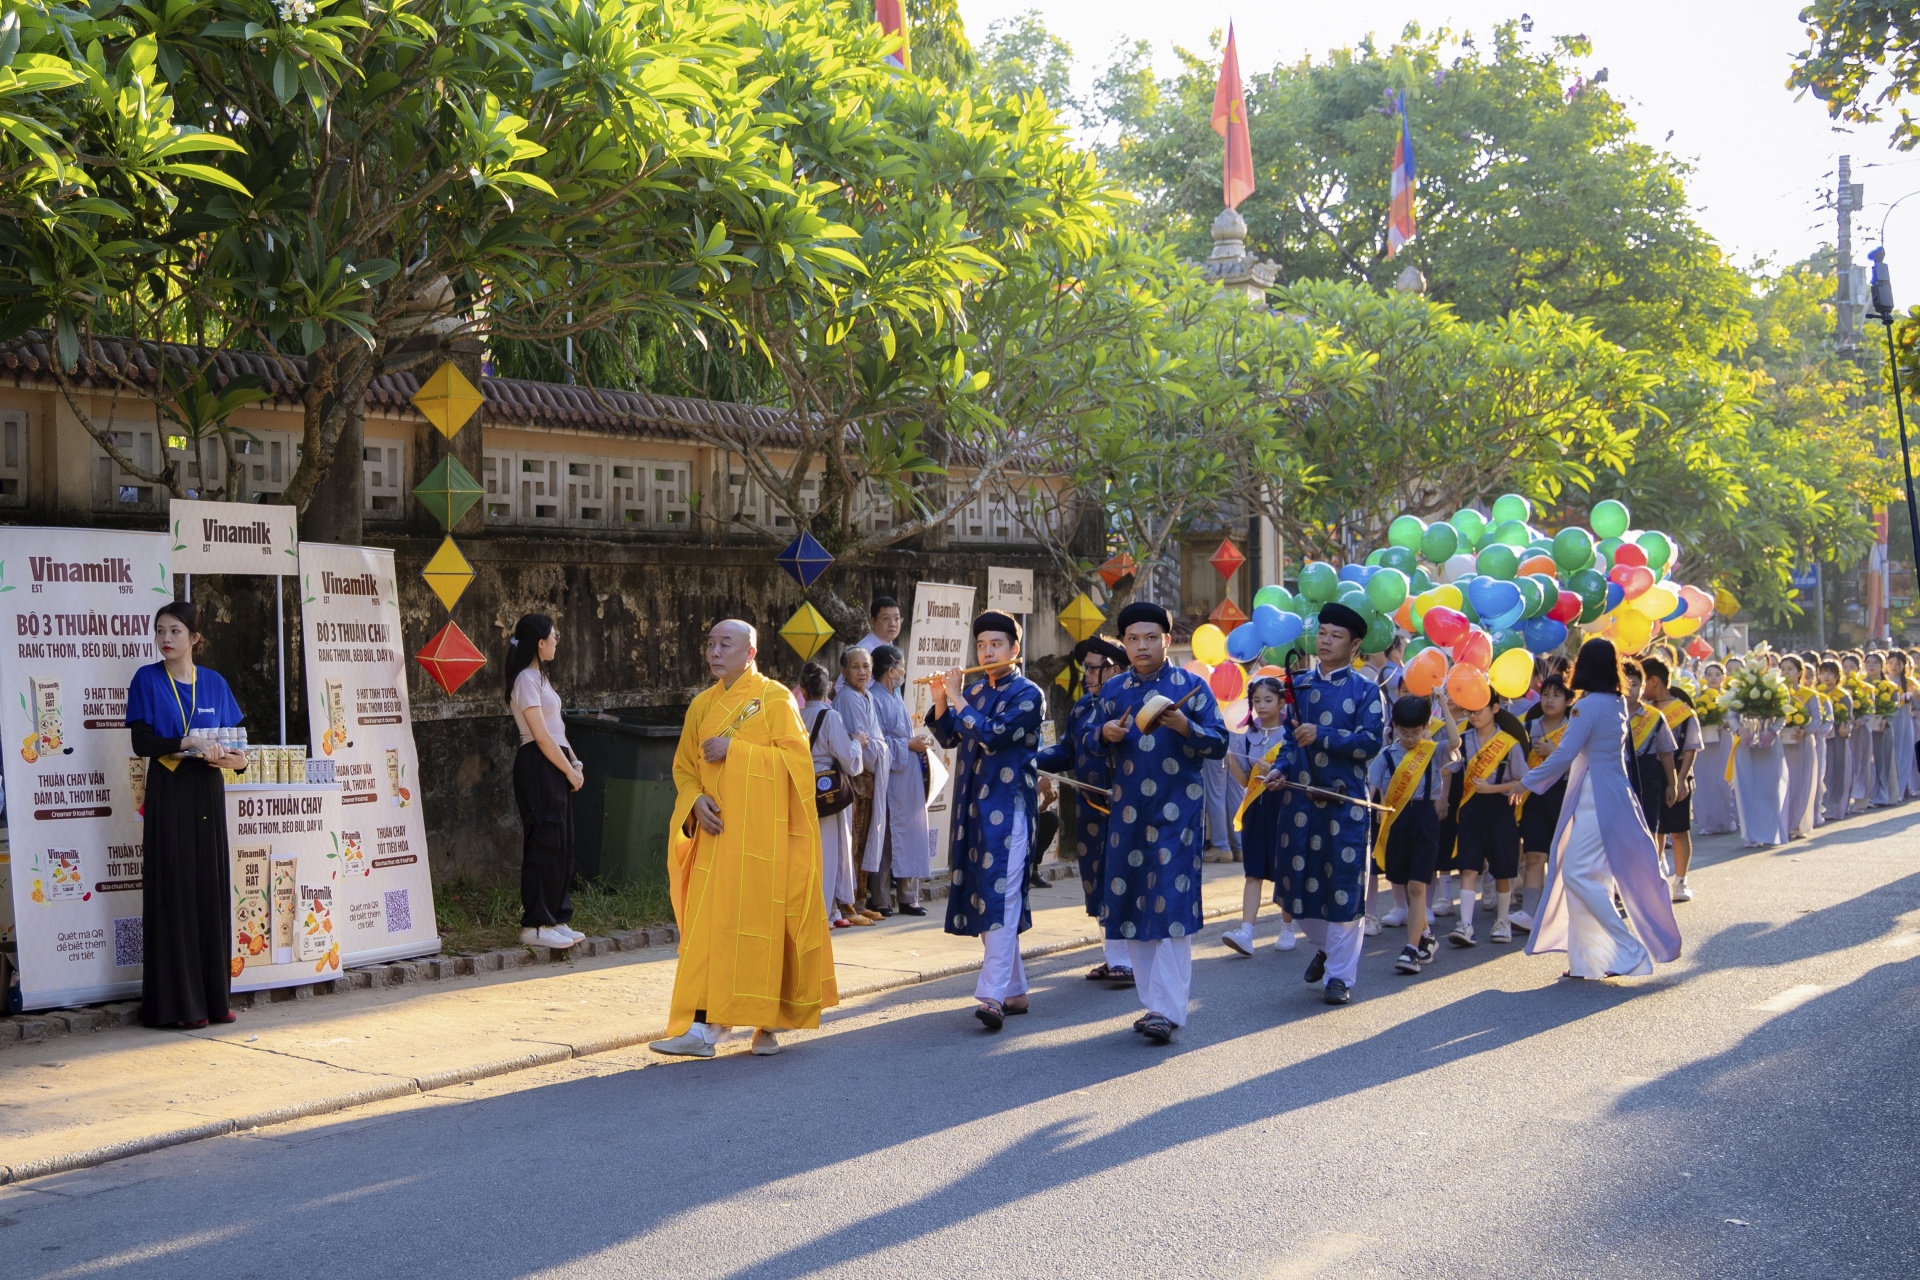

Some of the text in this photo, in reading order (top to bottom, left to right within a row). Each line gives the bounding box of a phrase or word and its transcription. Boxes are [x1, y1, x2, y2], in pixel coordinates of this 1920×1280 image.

[203, 519, 271, 544] Vinamilk
[262, 547, 271, 555] 1976
[29, 556, 133, 582] Vinamilk
[32, 584, 133, 594] EST 1976
[321, 571, 378, 596] Vinamilk
[999, 579, 1022, 594] Vinamilk
[927, 600, 960, 618] Vinamilk
[16, 609, 150, 638] BỘ 3 THUẦN CHAY
[317, 619, 390, 644] BỘ 3 THUẦN CHAY
[18, 641, 153, 659] RANG THƠM, BÉO BÙI, DẬY VỊ
[918, 636, 926, 653] BỘ
[926, 638, 930, 651] 3
[318, 649, 333, 662] RANG
[353, 648, 363, 662] BÉO
[84, 688, 90, 700] 9
[92, 688, 106, 701] HẠT
[108, 688, 125, 700] TINH
[356, 689, 360, 699] 9
[83, 704, 104, 716] RANG
[67, 773, 87, 786] CHAY
[69, 790, 93, 803] THƠM
[96, 789, 110, 803] HẠT
[239, 794, 322, 819] BỘ 3 THUẦN CHAY
[239, 823, 257, 835] RANG
[259, 822, 281, 835] THƠM,
[282, 820, 293, 833] BÉO
[48, 849, 80, 859] Vinamilk
[238, 849, 266, 858] Vinamilk
[123, 862, 139, 875] TIÊU
[246, 876, 259, 888] HẠT
[301, 885, 332, 900] Vinamilk
[58, 931, 77, 941] Quét
[92, 929, 103, 938] QR
